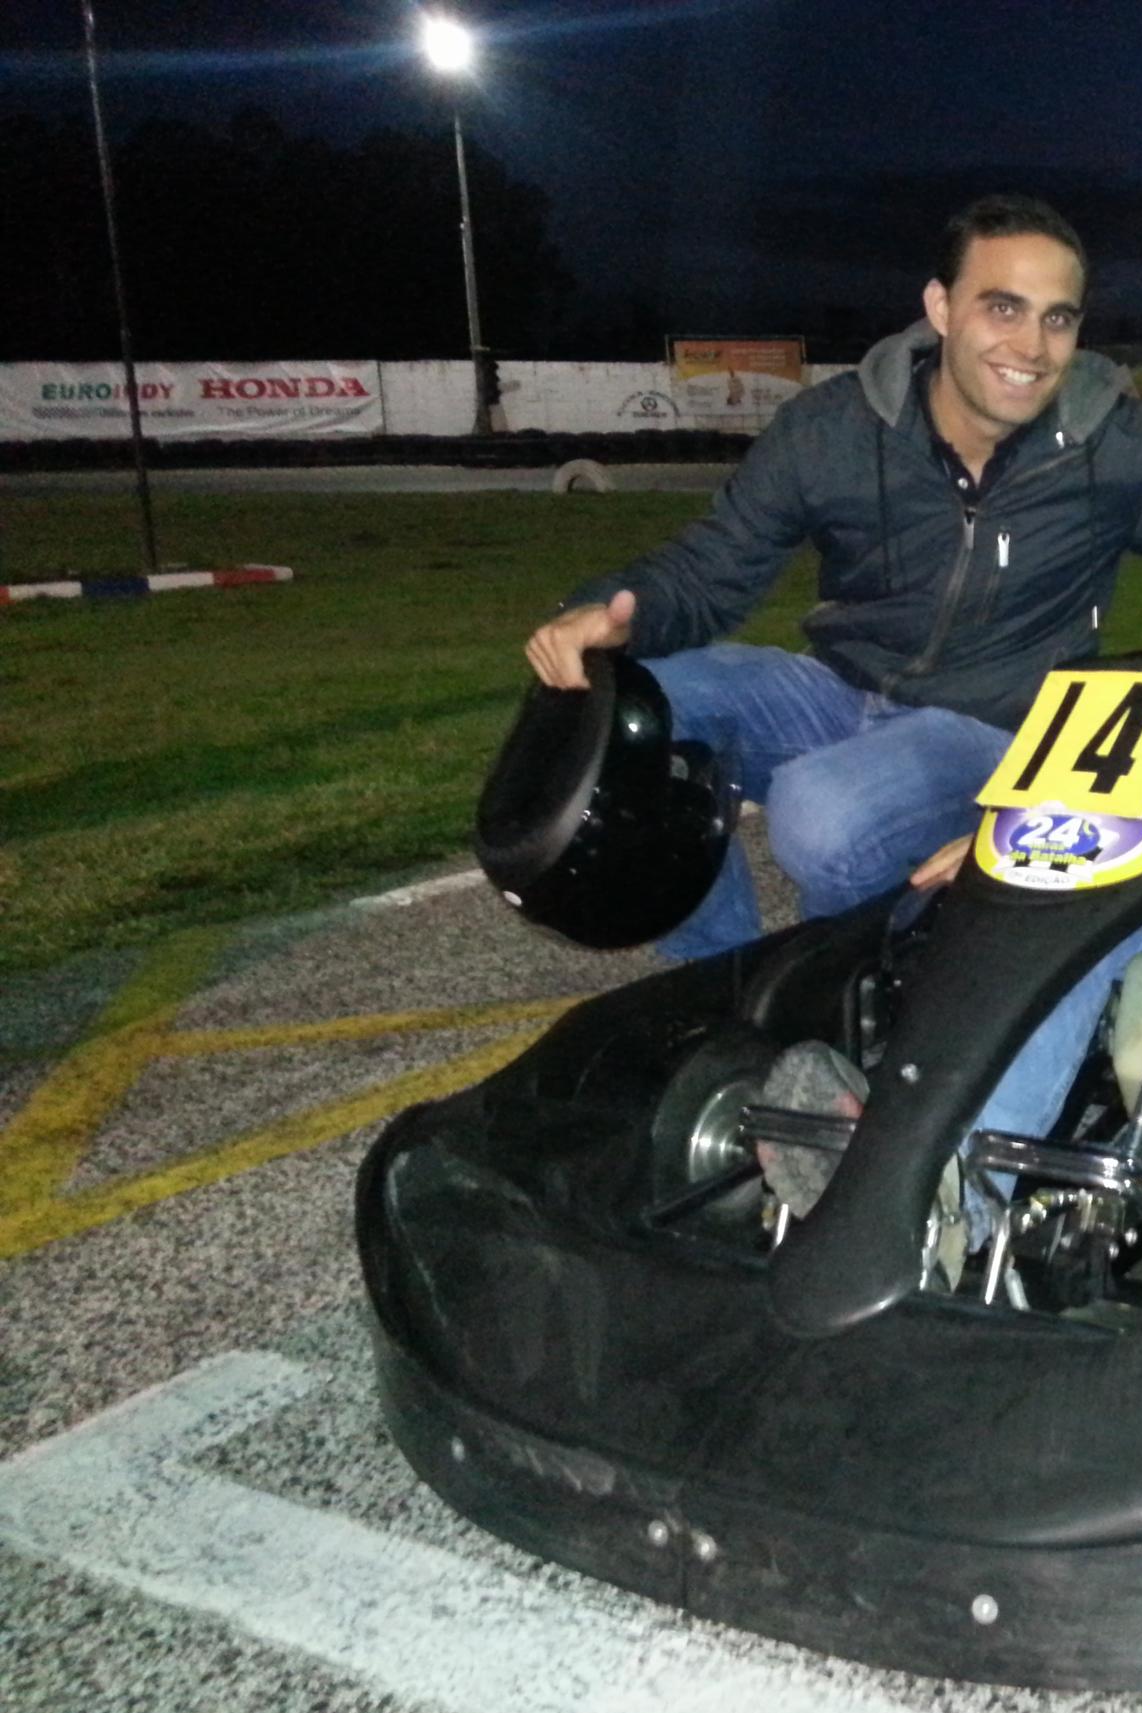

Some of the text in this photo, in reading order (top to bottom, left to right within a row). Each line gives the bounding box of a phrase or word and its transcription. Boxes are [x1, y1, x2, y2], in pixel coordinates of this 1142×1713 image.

[41, 383, 175, 400] EUROIDY
[199, 376, 371, 400] HONDA
[218, 406, 243, 417] The
[247, 405, 289, 417] Power
[293, 405, 305, 417] of
[1016, 815, 1083, 848] 24
